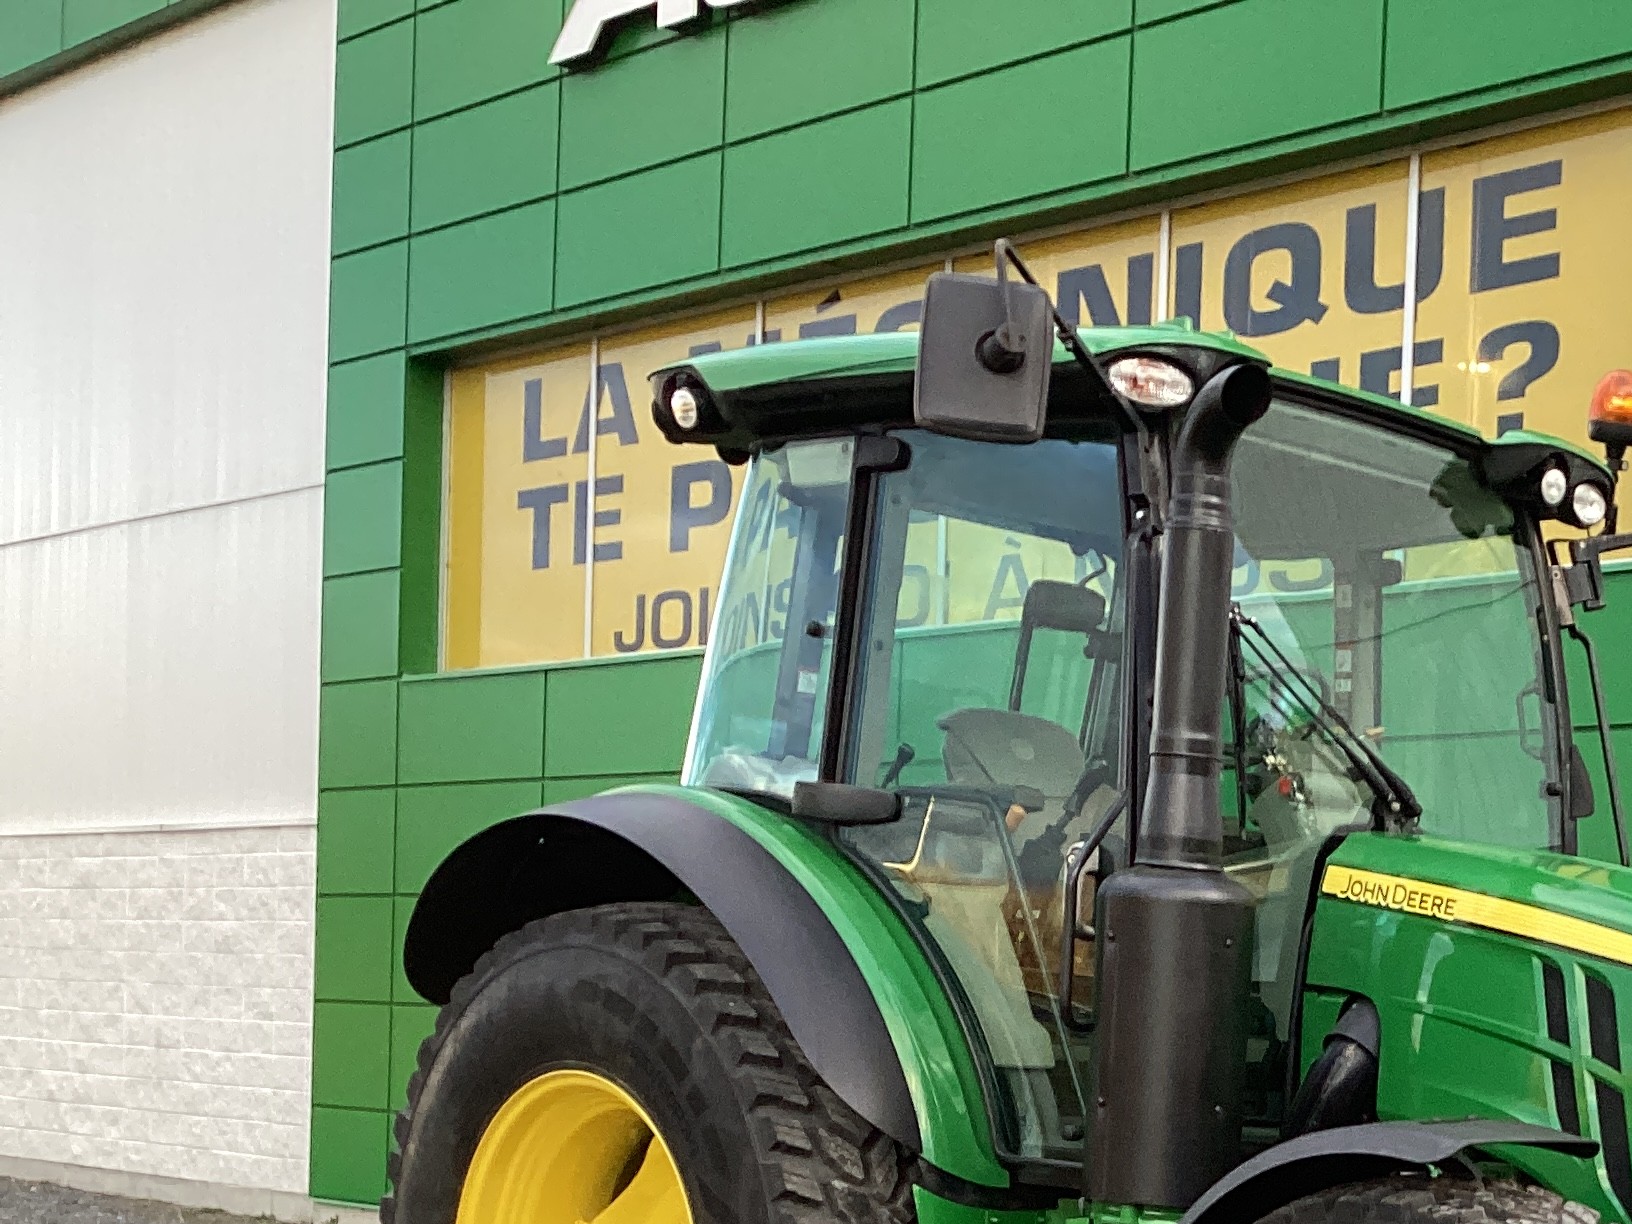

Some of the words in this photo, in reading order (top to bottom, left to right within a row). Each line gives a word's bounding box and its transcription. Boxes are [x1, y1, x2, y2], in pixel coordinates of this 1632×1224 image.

[523, 362, 640, 463] LA
[517, 475, 624, 570] TE
[1340, 874, 1390, 901] JOHN
[1391, 884, 1457, 917] DEERE
